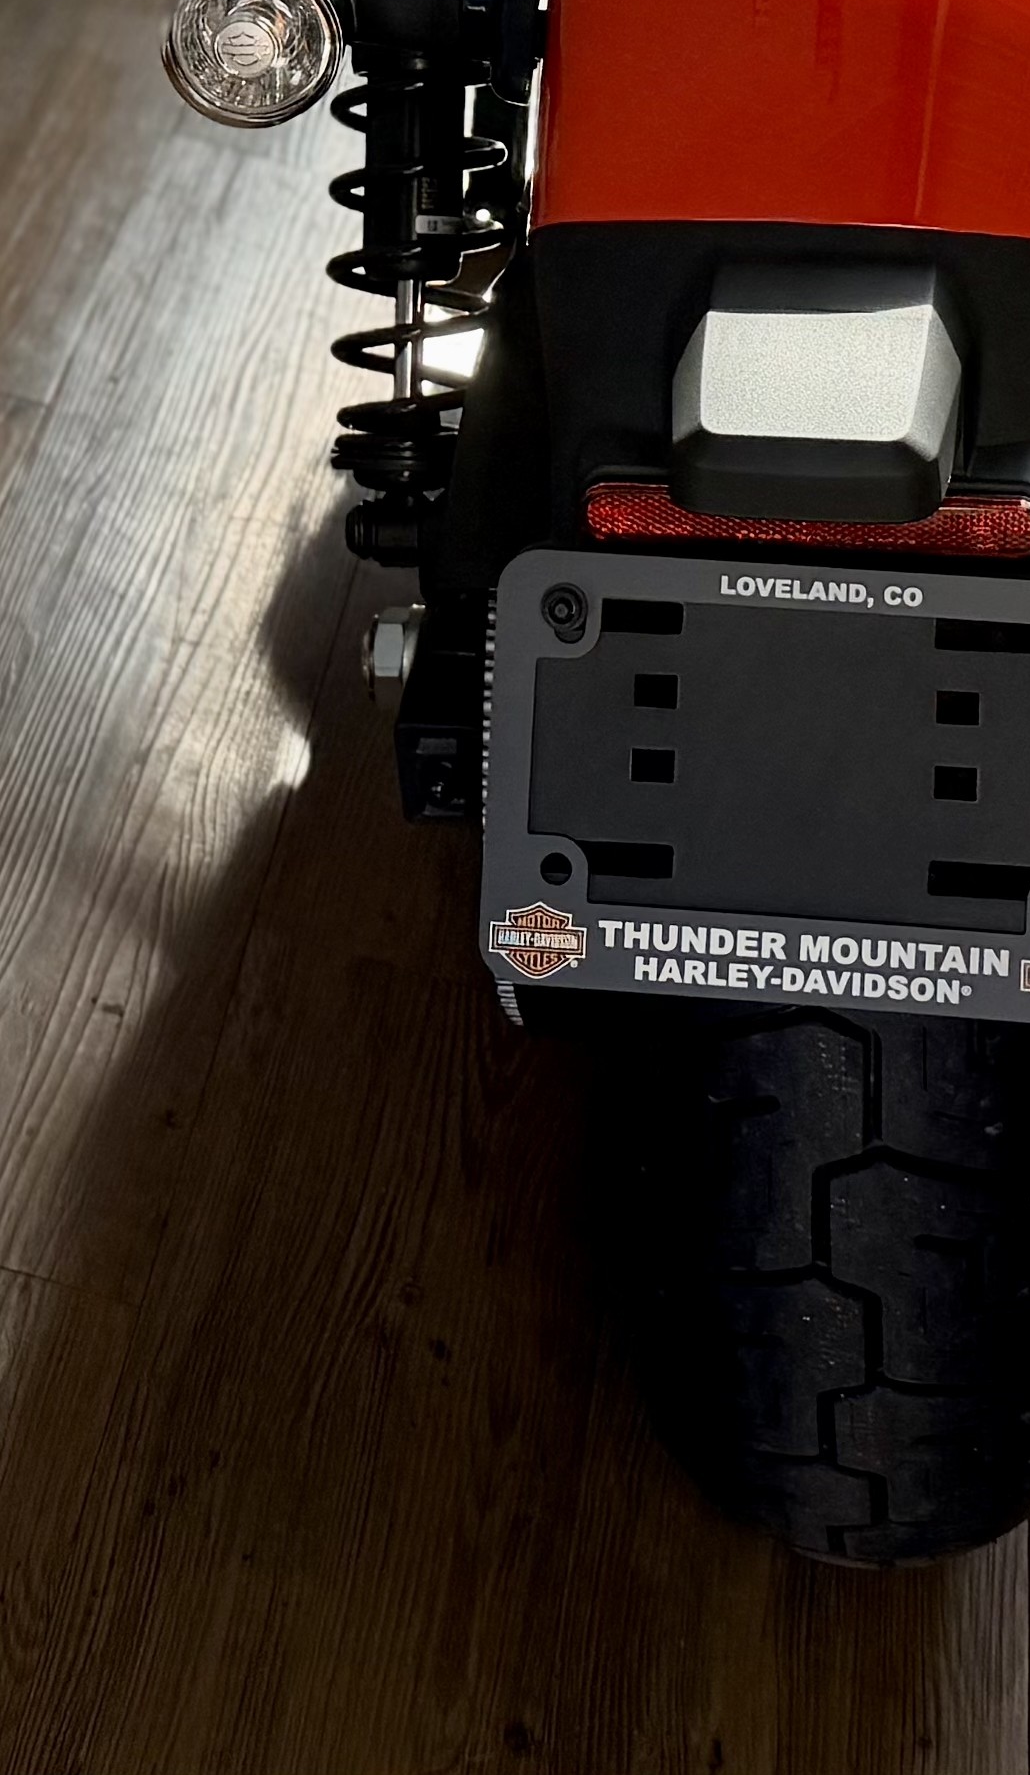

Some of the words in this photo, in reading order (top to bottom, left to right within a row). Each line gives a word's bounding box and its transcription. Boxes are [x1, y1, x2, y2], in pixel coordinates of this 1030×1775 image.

[720, 575, 875, 609] LOVELAND,
[883, 585, 924, 608] CO
[599, 920, 787, 960] THUNDER
[799, 934, 1010, 977] MOUNTAIN
